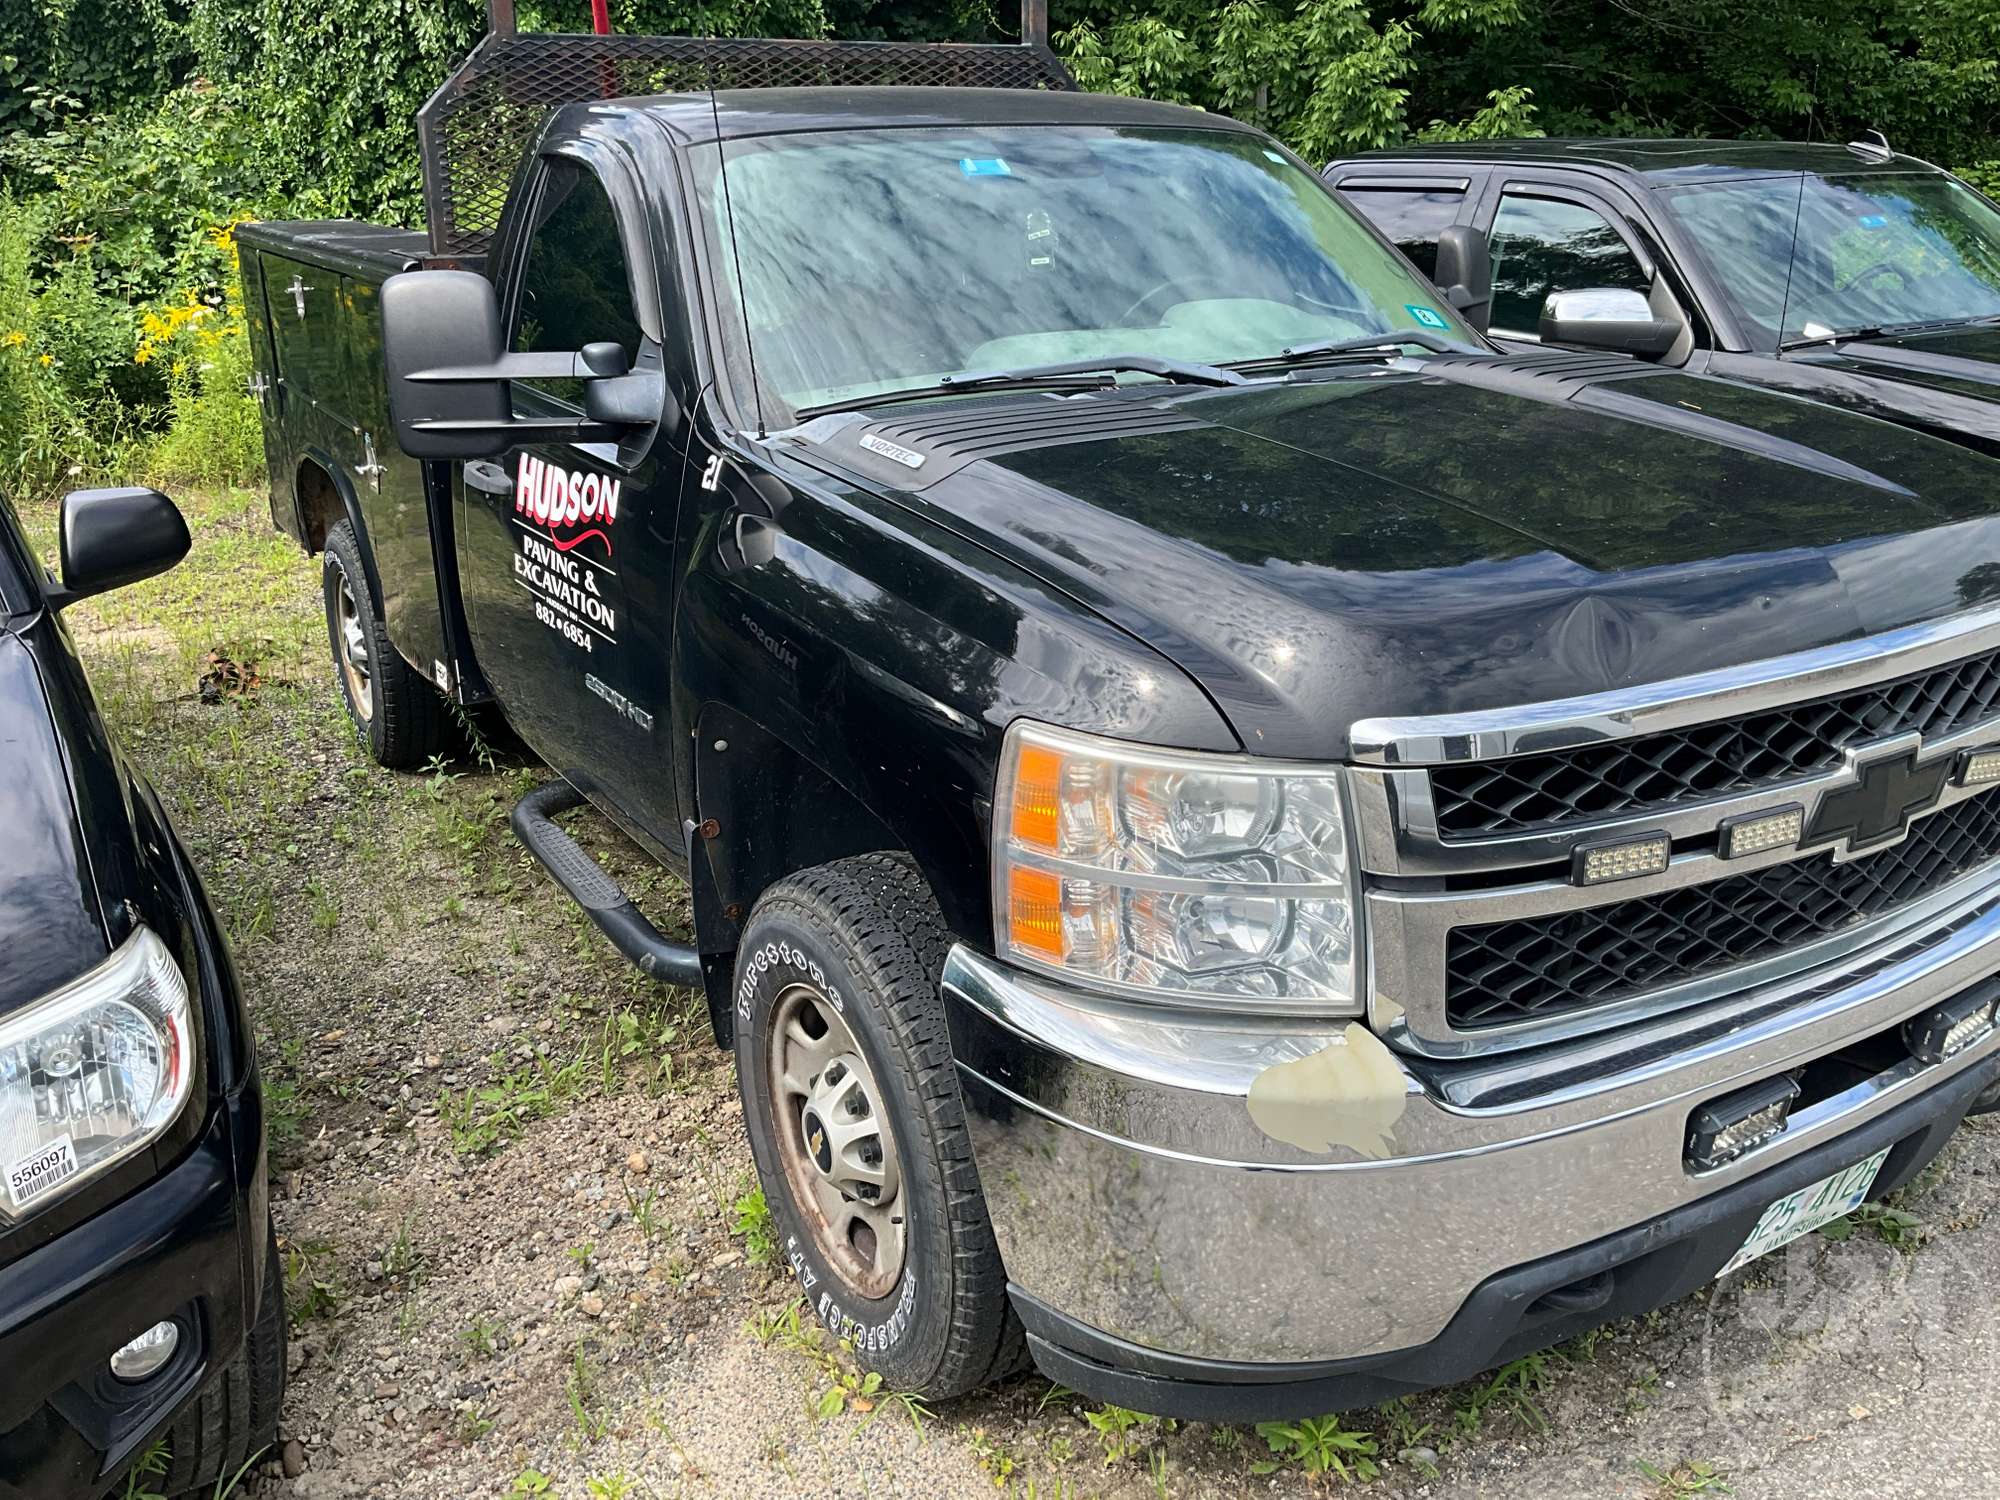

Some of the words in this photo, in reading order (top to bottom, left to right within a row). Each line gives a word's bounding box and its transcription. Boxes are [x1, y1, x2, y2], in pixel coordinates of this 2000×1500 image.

[701, 454, 724, 491] 21
[870, 439, 916, 463] VORTEC
[516, 451, 621, 528] HUDSON
[514, 552, 616, 632] EXCAVATION
[523, 534, 579, 585] PAVING
[584, 569, 602, 597] &
[737, 940, 844, 1021] Firestone
[11, 1145, 67, 1188] 556097
